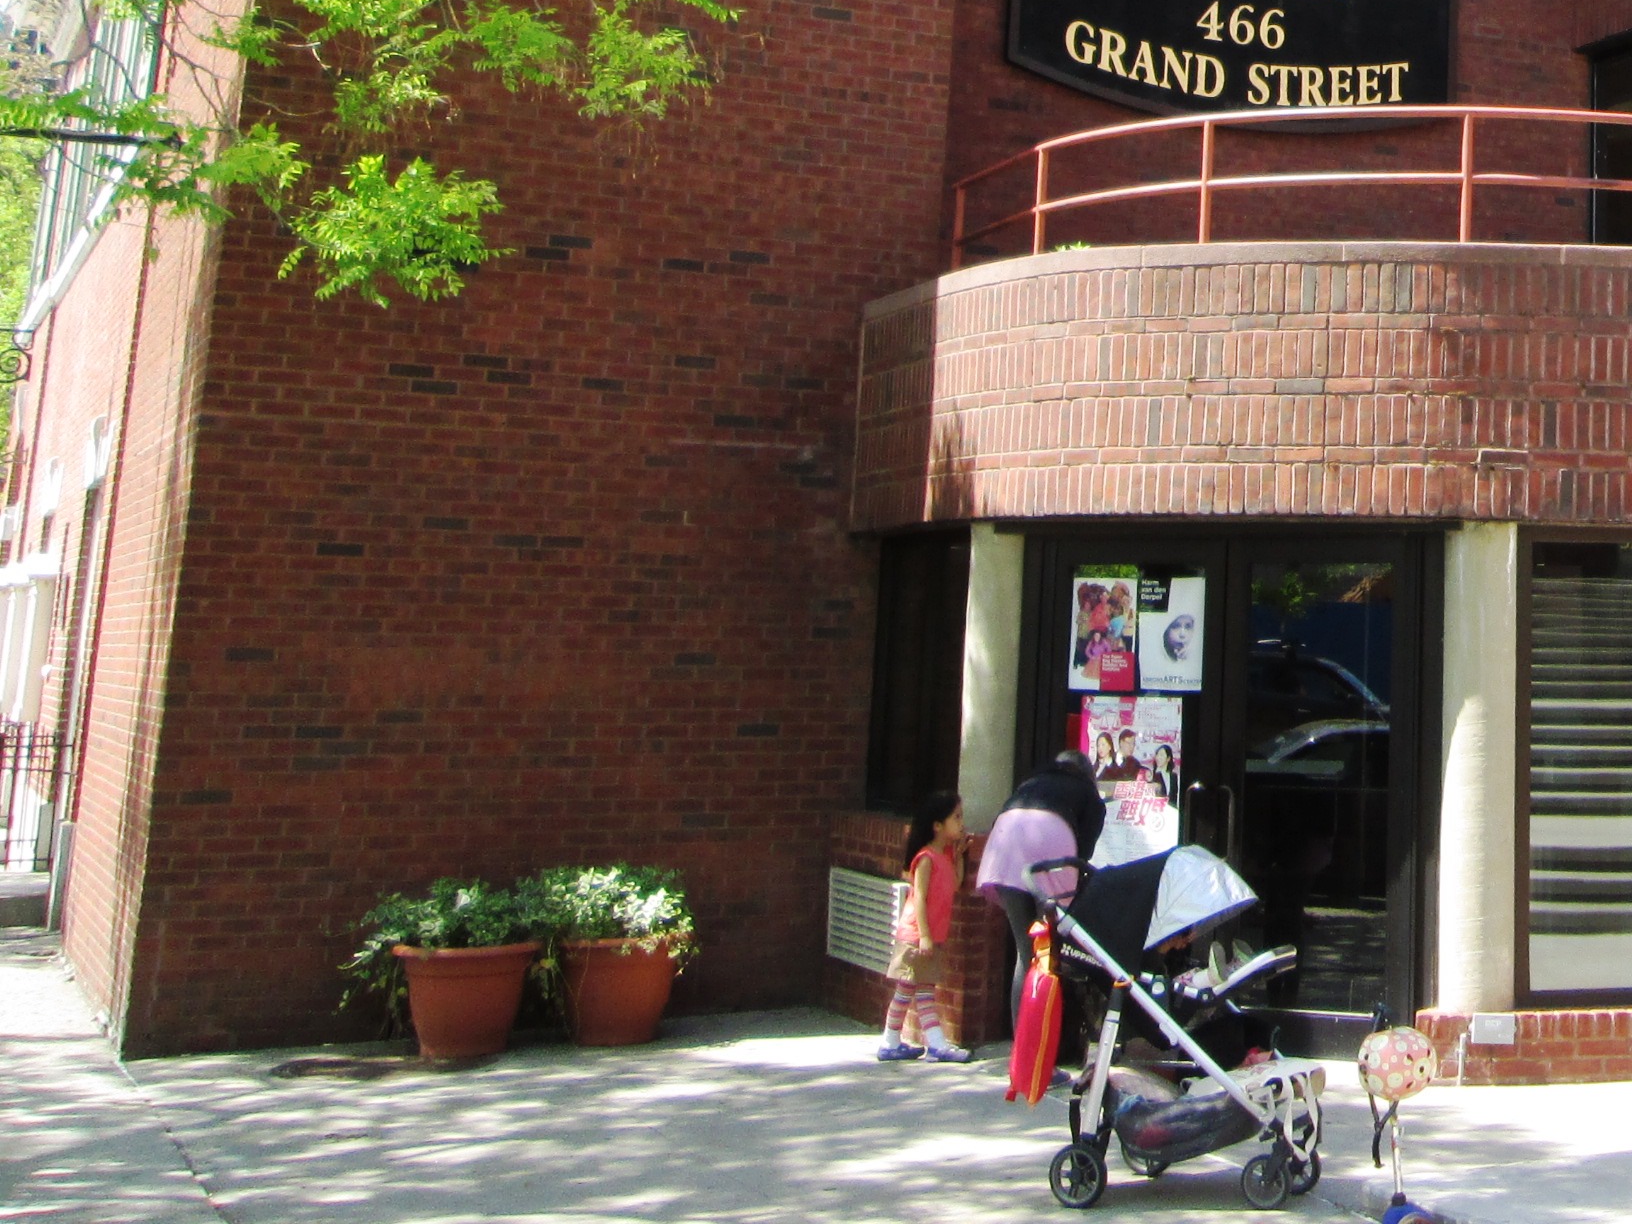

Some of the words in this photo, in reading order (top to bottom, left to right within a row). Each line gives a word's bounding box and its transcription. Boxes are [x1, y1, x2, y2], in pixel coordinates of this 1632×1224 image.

[1196, 0, 1285, 49] 466
[1064, 20, 1225, 98] GRAND
[1247, 62, 1408, 108] STREET
